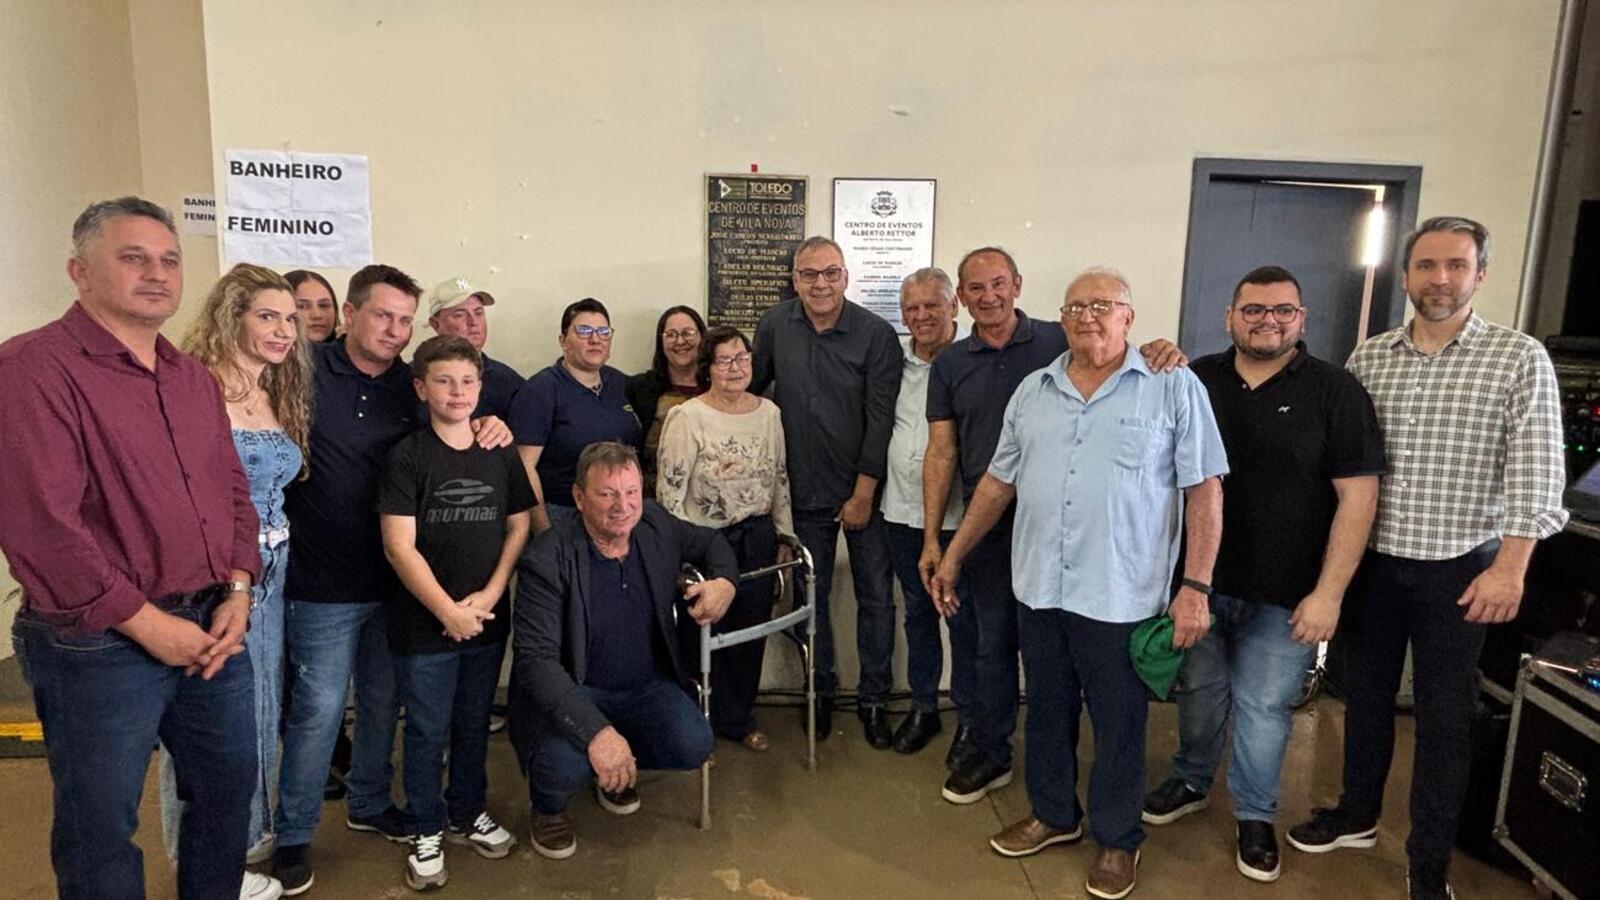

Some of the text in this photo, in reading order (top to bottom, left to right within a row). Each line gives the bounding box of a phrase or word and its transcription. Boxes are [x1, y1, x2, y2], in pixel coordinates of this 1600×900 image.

[230, 160, 342, 181] BANHEIRO
[749, 182, 793, 194] TOLEDO
[709, 201, 805, 215] CENTRO DE EVENTOS
[228, 216, 334, 236] FEMININO
[721, 216, 791, 229] DE VILA NOVA
[845, 221, 875, 229] CENTRO
[851, 229, 916, 237] ALBERTO RETTOR
